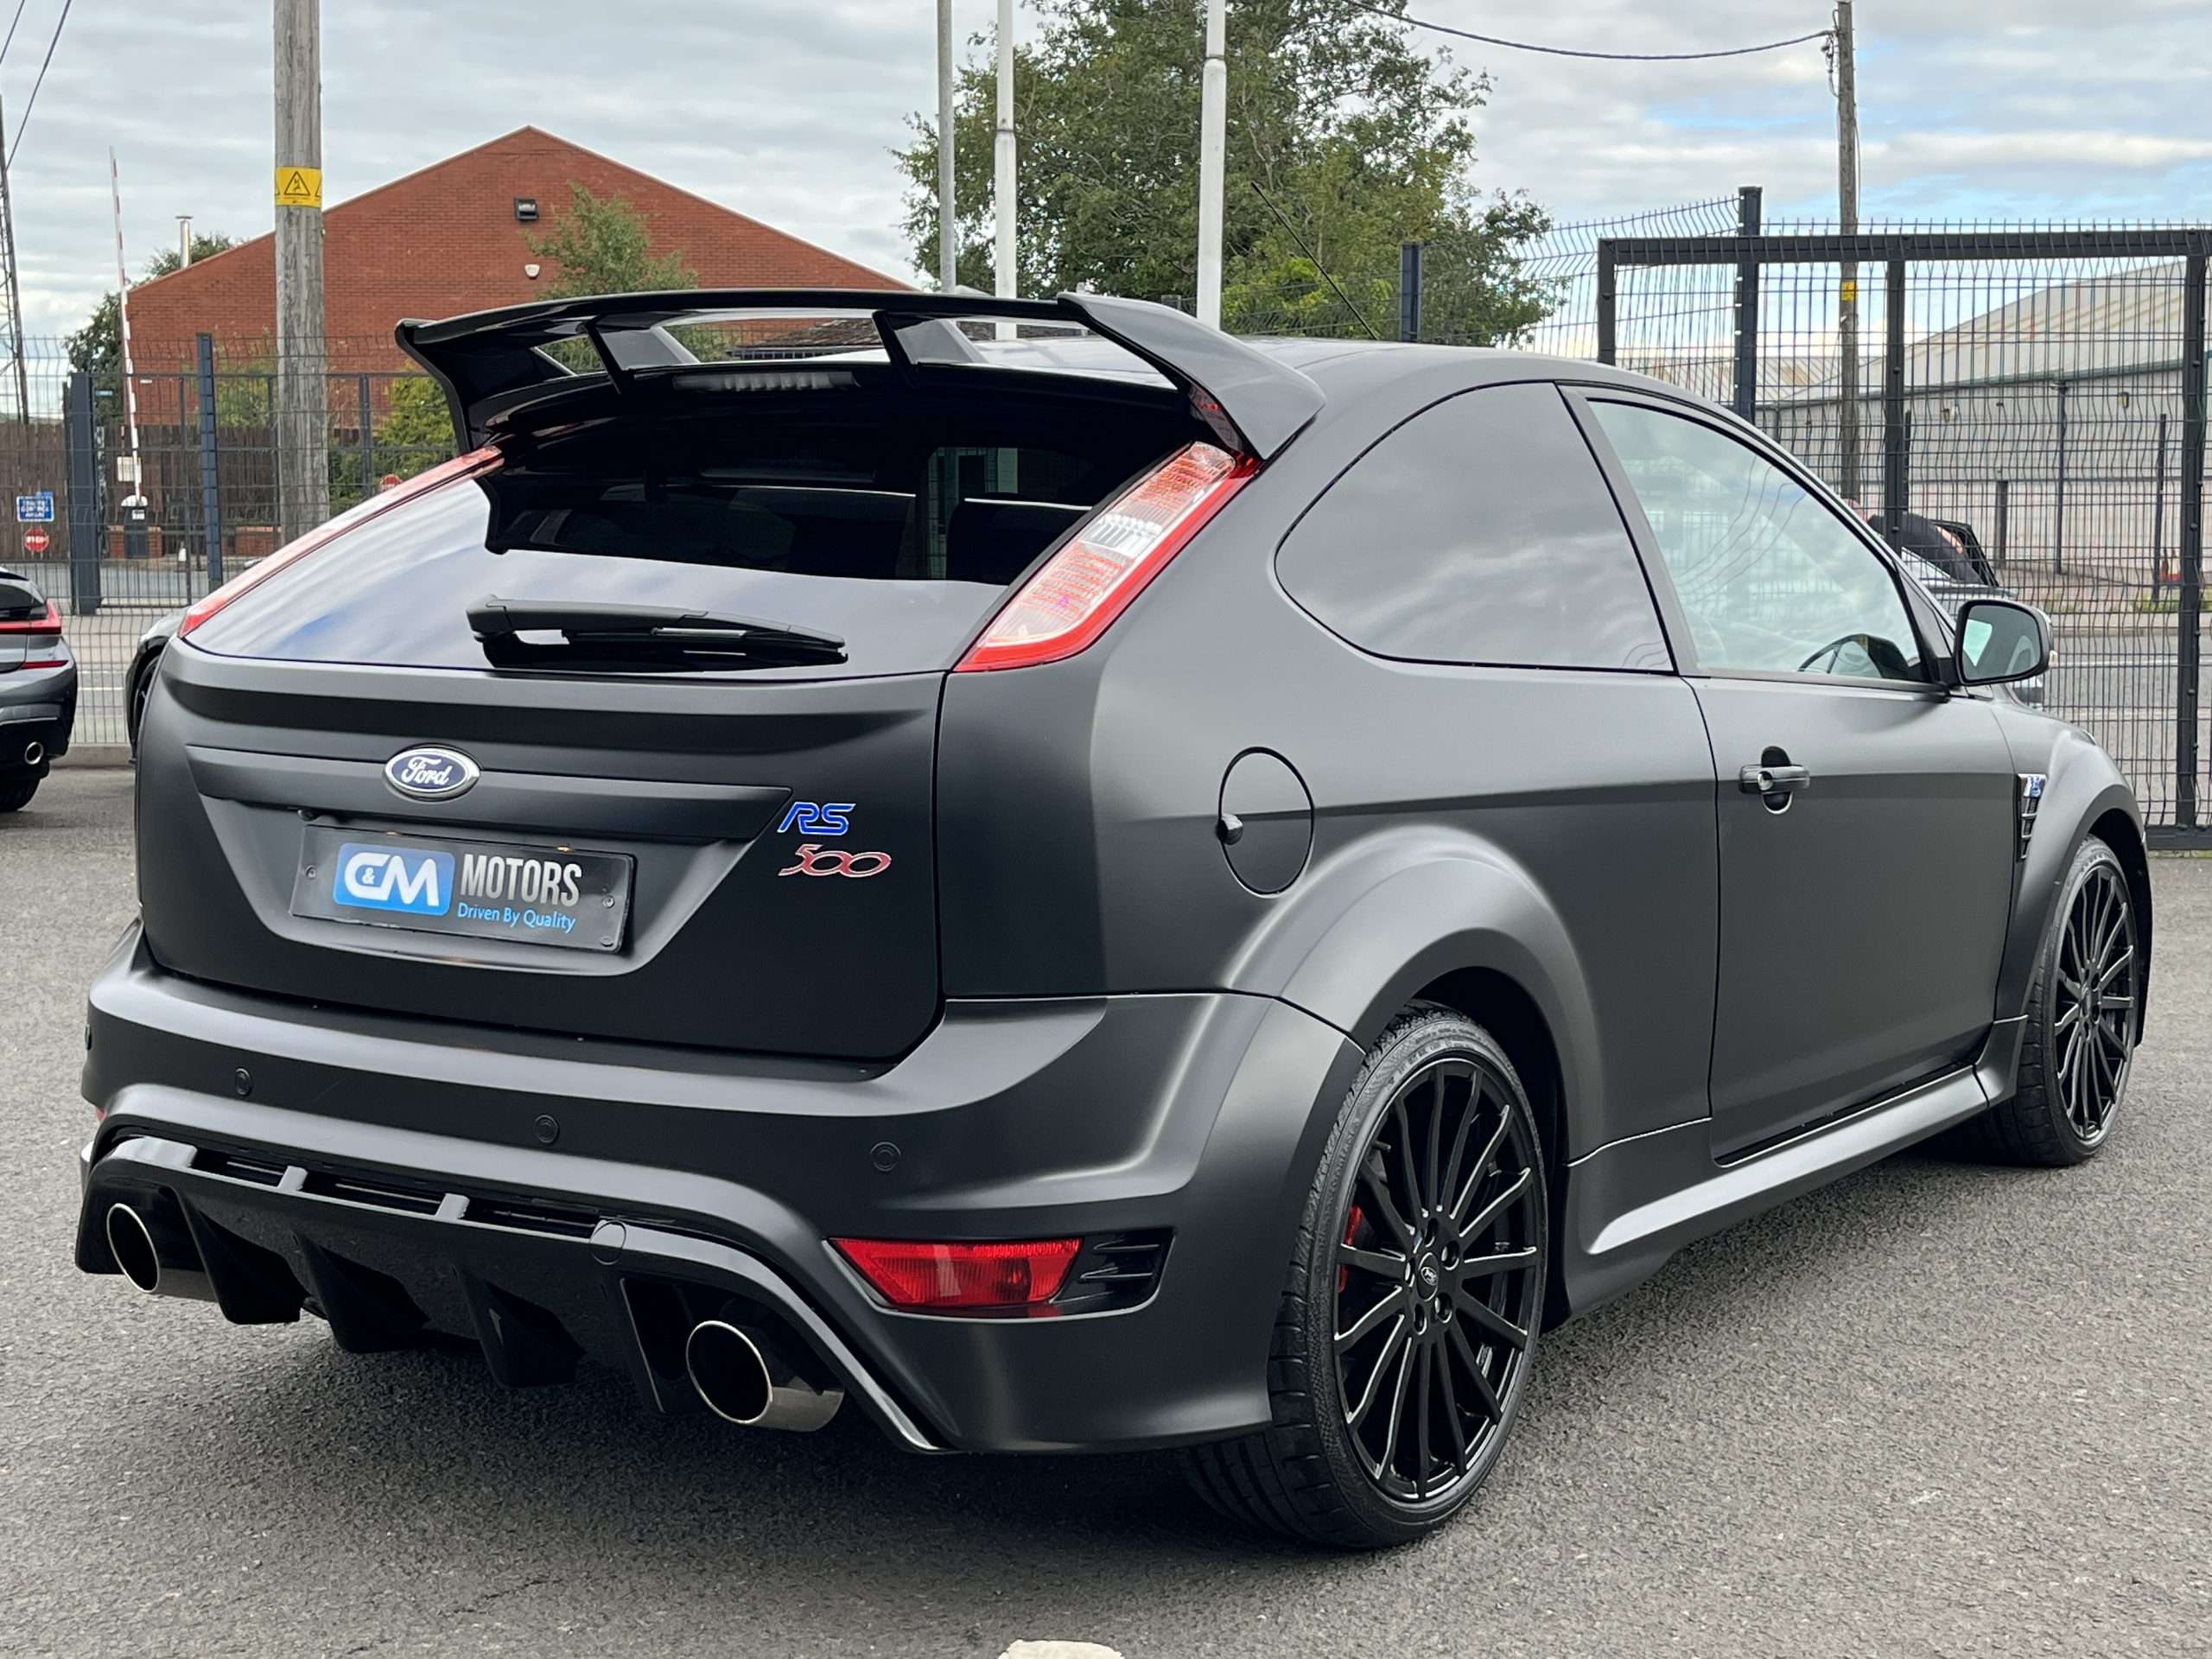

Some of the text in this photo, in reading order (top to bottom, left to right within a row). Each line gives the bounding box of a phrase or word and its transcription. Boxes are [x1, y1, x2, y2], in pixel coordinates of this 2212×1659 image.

[401, 756, 454, 785] Ford
[777, 802, 856, 836] RS
[778, 843, 892, 878] 500
[345, 852, 582, 907] C&M MOTORS
[457, 902, 575, 933] Driven By Quality
